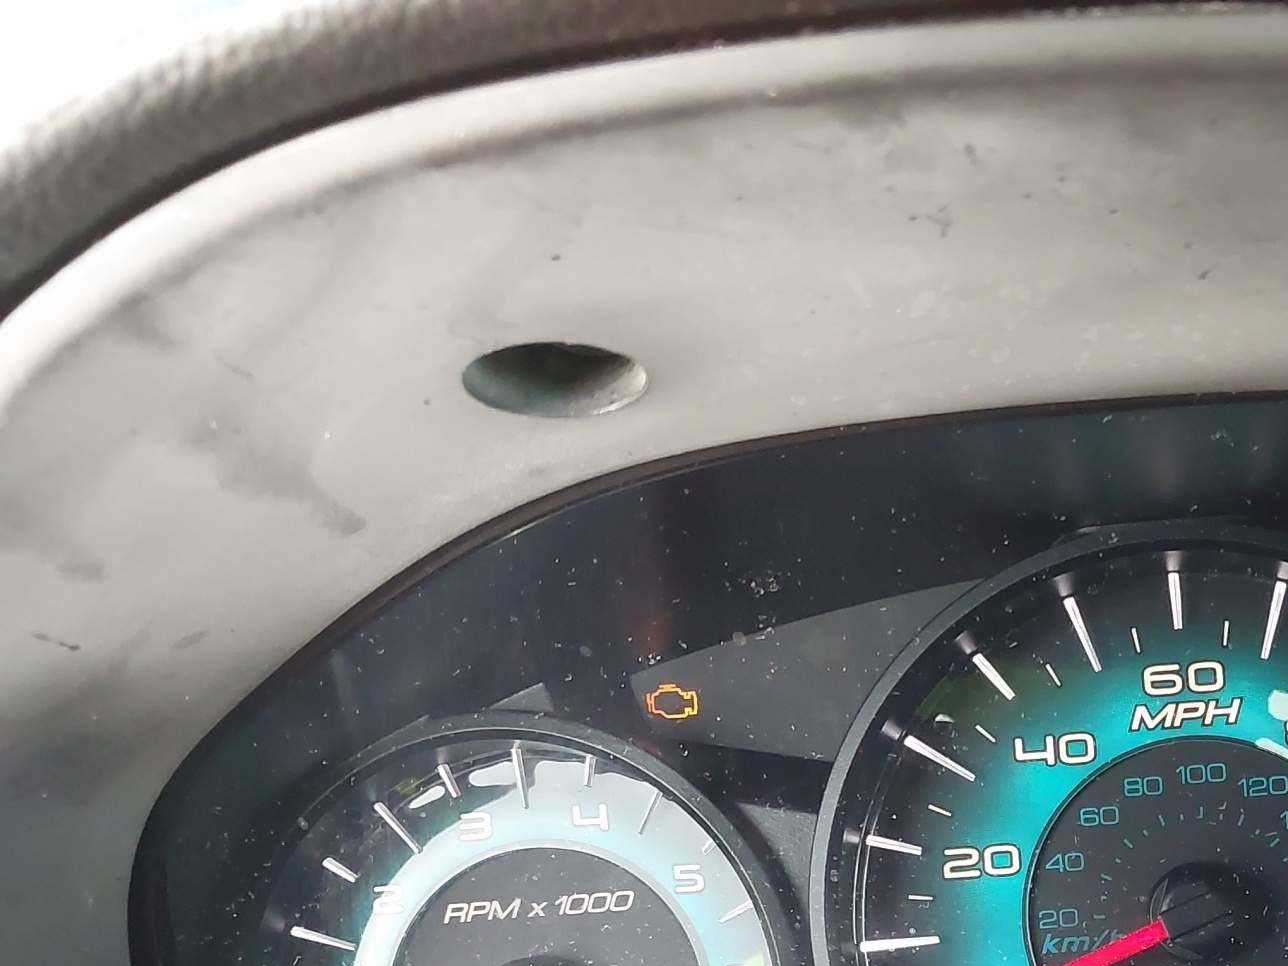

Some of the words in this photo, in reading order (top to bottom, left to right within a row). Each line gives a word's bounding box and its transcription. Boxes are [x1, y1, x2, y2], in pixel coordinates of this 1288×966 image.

[1143, 660, 1225, 693] 60
[1129, 699, 1242, 732] MPH
[1013, 732, 1096, 766] 40
[1122, 775, 1163, 798] 80
[1176, 763, 1226, 785] 100
[1238, 774, 1288, 797] 120
[460, 811, 493, 841] 3
[572, 802, 609, 830] 4
[1078, 804, 1120, 827] 60
[942, 843, 1022, 880] 20
[1045, 851, 1085, 873] 40
[673, 864, 704, 893] 5
[442, 895, 521, 925] RPM
[526, 902, 546, 918] x
[550, 889, 635, 916] 1000
[1038, 908, 1078, 929] 20
